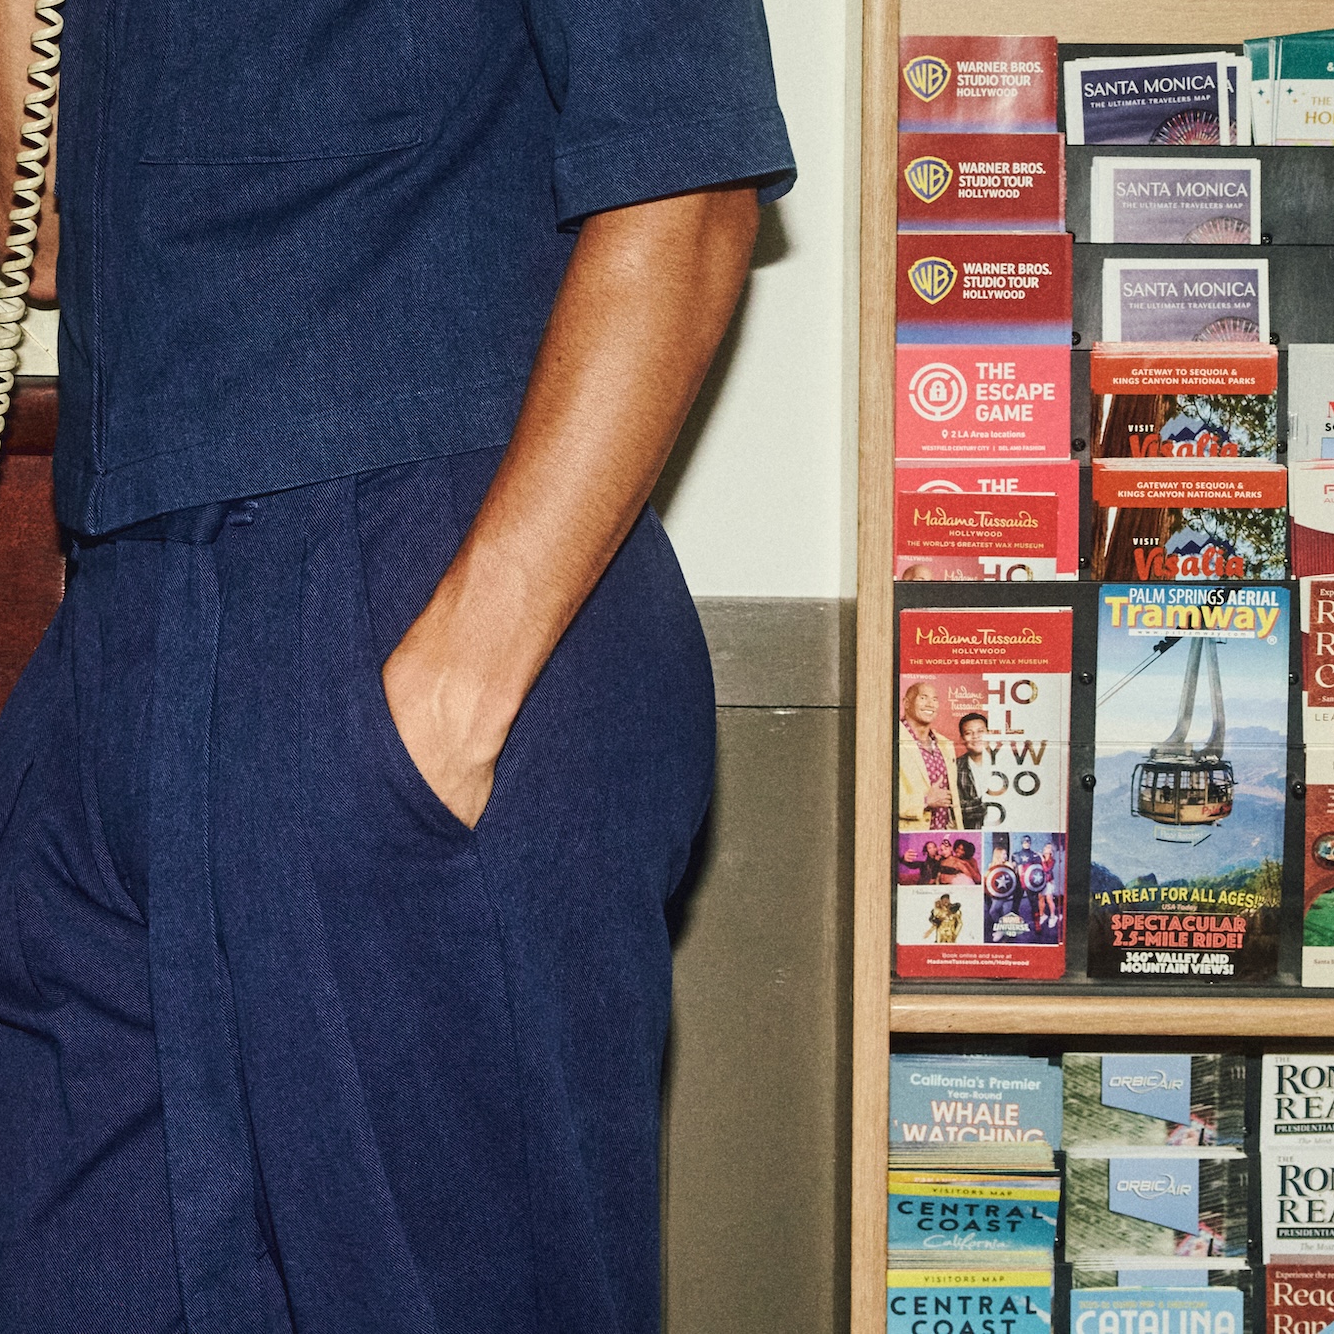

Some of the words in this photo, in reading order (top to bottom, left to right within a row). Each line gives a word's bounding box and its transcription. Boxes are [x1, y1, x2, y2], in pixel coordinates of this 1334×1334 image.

[1105, 597, 1282, 636] Tramway
[1111, 914, 1247, 933] SPECTACULAR
[1112, 931, 1194, 949] 2.5-MILE
[1198, 931, 1242, 949] RIDE!
